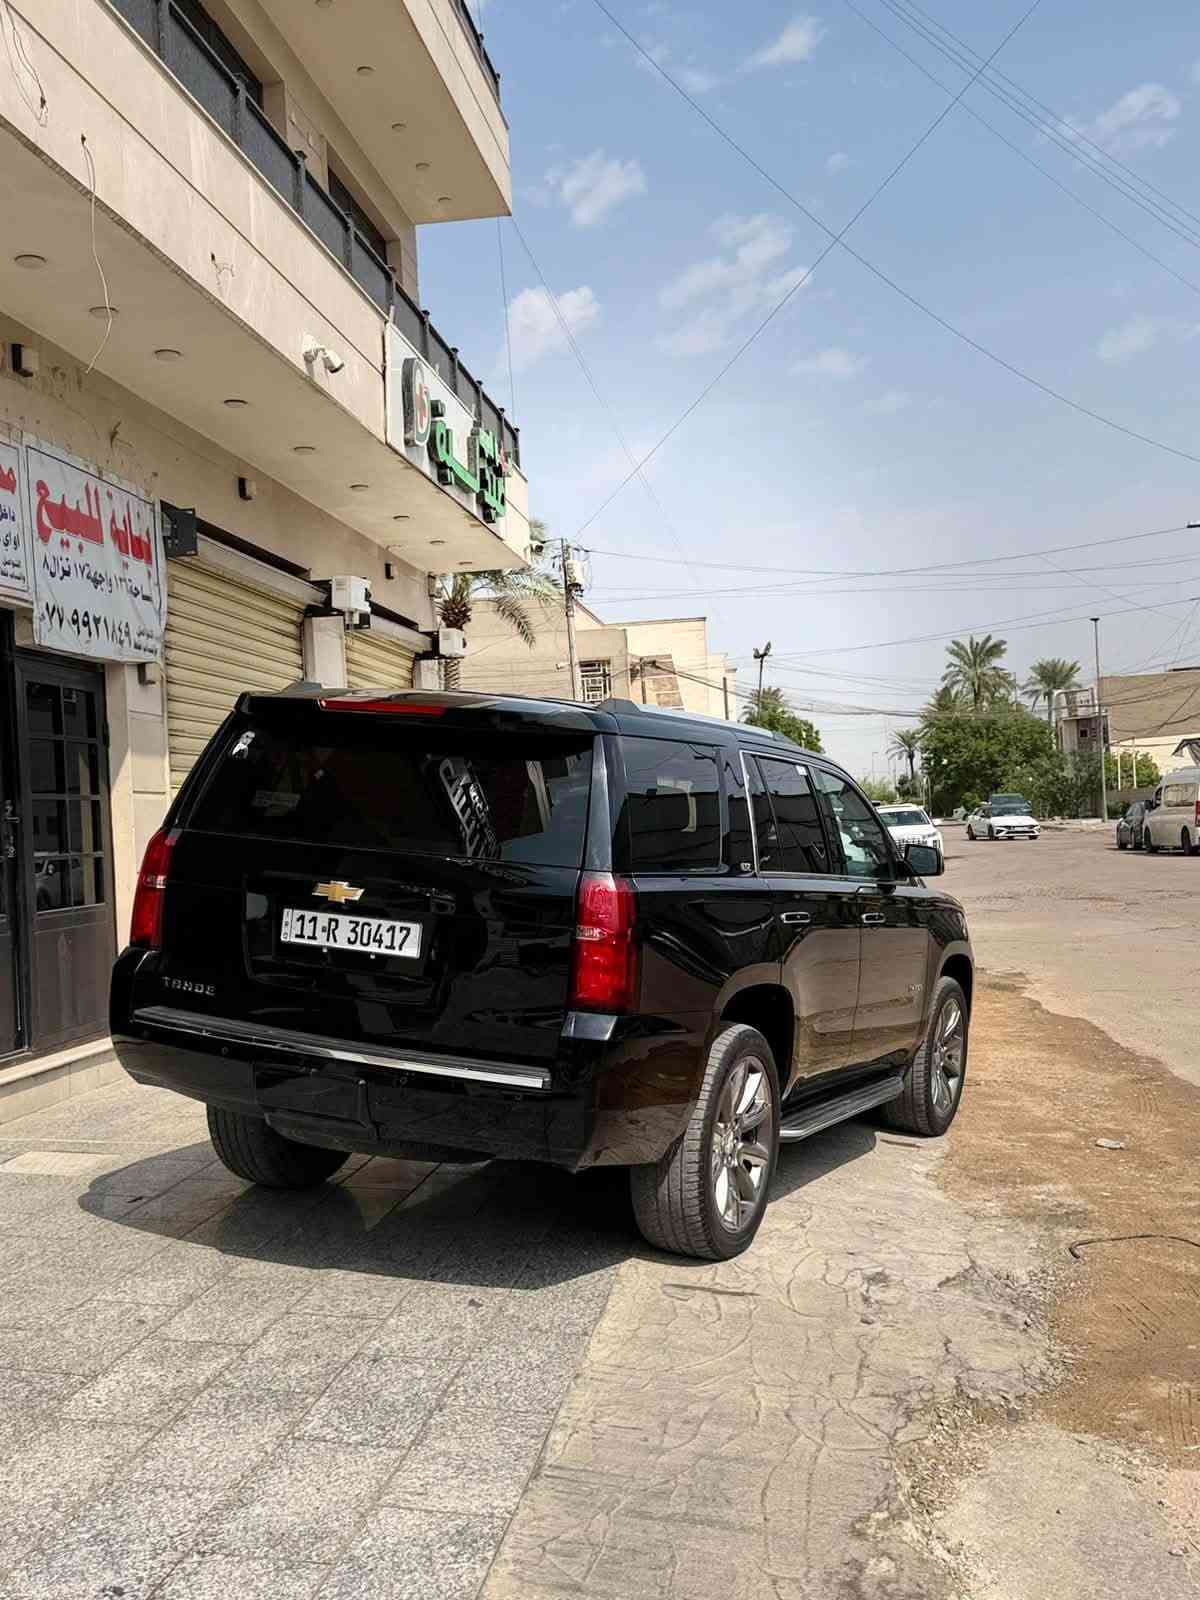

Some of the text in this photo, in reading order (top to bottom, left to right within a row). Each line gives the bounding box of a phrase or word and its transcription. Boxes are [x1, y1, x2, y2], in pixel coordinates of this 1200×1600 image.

[36, 478, 153, 576] بناية للبيع
[294, 913, 412, 952] 11 R 30417
